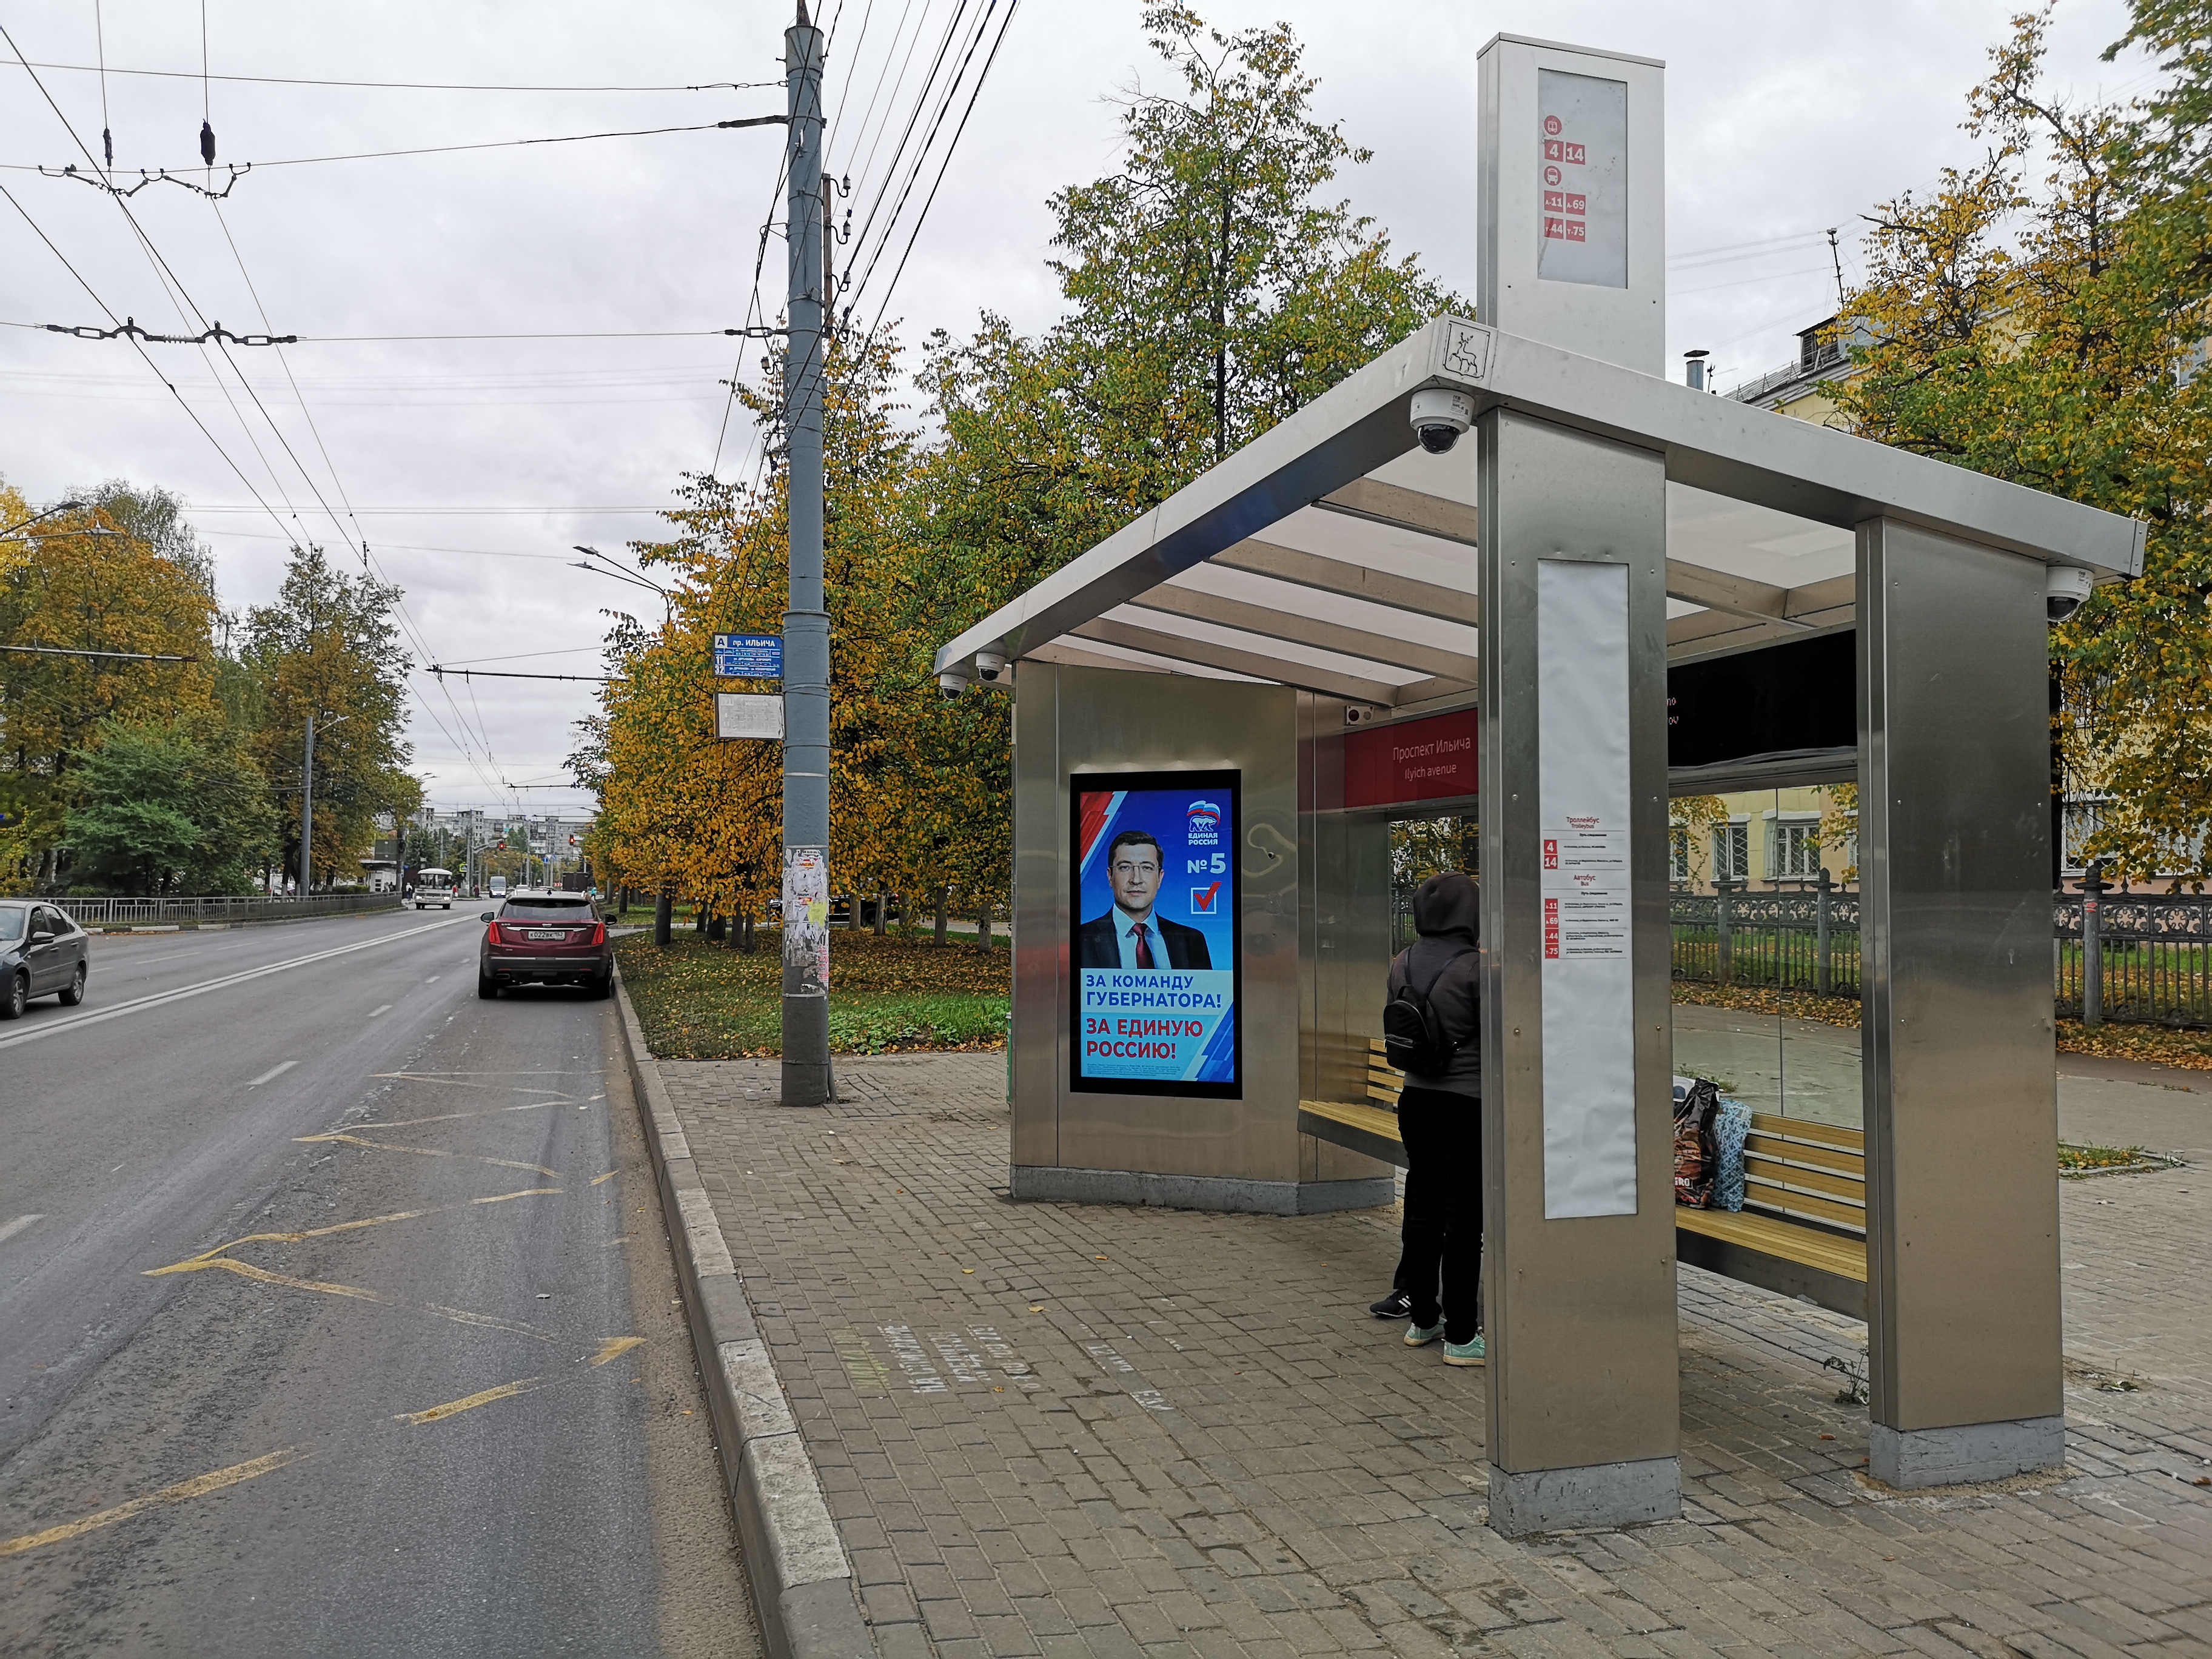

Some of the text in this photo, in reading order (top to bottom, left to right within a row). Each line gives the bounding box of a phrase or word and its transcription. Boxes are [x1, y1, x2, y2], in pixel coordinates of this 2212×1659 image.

[1549, 144, 1584, 161] 4 14
[716, 655, 723, 665] 11
[1393, 737, 1471, 763] Проспект Ильича
[1405, 763, 1456, 782] Ilyich avenue
[1547, 842, 1553, 851] 4
[1545, 857, 1557, 866] 14
[1086, 975, 1193, 990] ЗА КОМАНДУ
[1086, 992, 1221, 1009] ГУБЕРНАТОРА!
[1086, 1019, 1202, 1037] ЗА ЕДИНУЮ
[1086, 1041, 1176, 1059] РОССИЮ!
